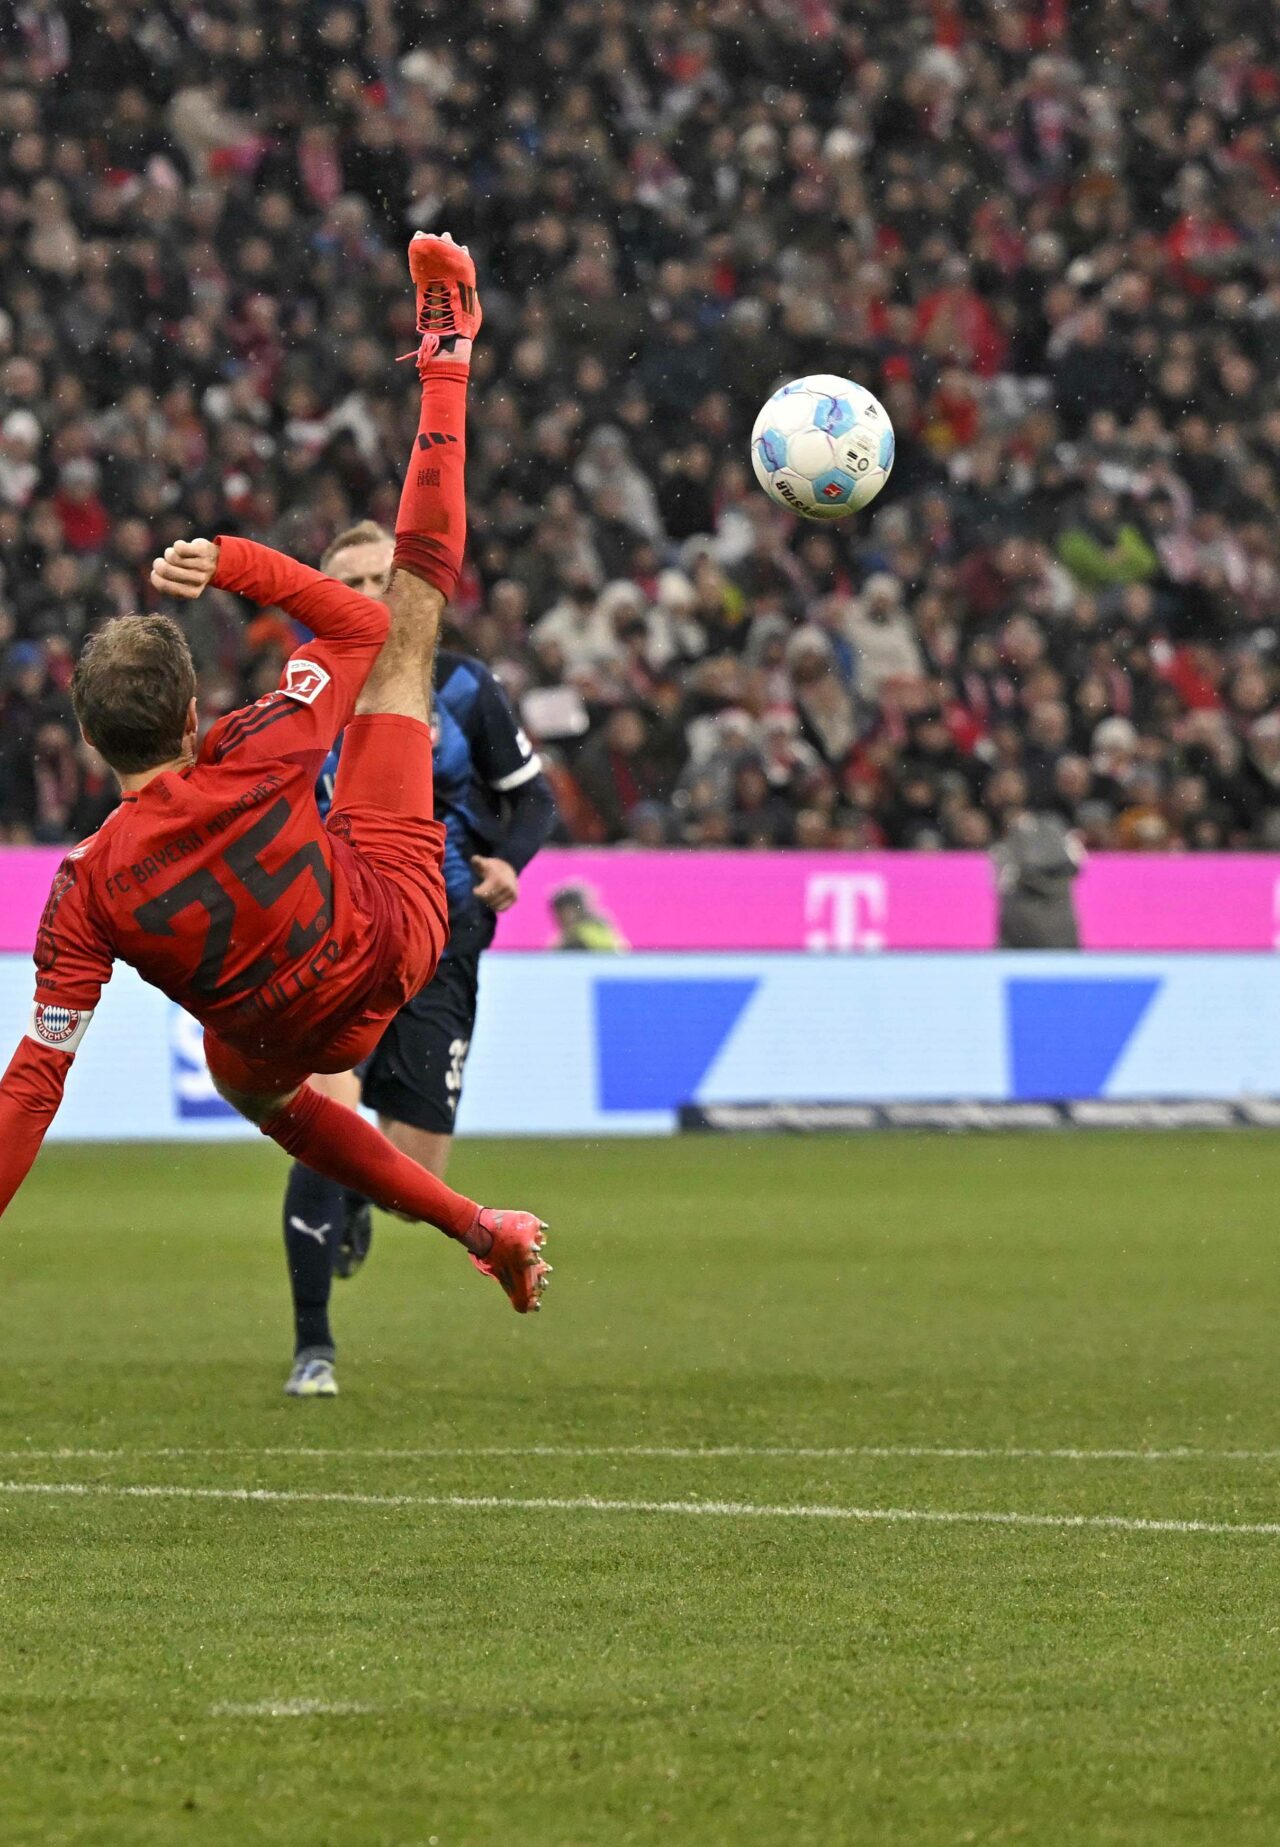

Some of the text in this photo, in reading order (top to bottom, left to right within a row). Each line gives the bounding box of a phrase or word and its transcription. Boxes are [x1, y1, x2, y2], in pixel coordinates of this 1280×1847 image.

[104, 870, 131, 900] FC
[130, 827, 204, 884] BAYERN
[133, 795, 335, 1002] 25
